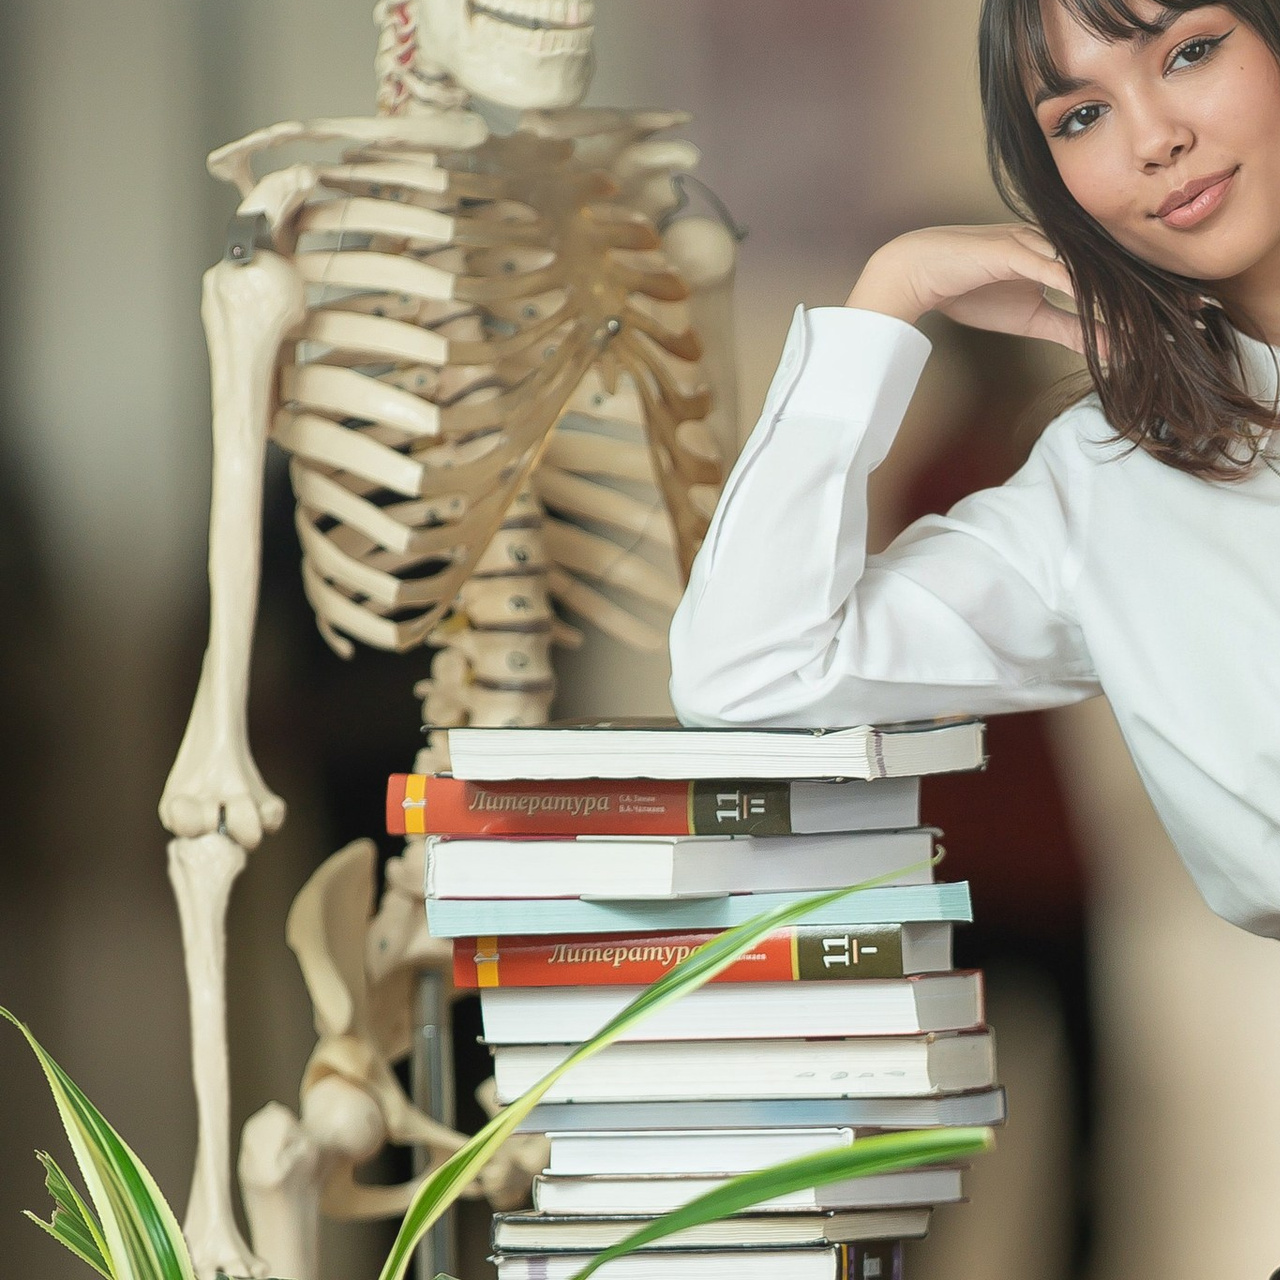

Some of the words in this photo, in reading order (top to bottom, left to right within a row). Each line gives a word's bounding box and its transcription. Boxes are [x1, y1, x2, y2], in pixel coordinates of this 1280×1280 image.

[468, 791, 611, 816] Литература
[716, 790, 740, 823] 11
[822, 934, 850, 969] 11
